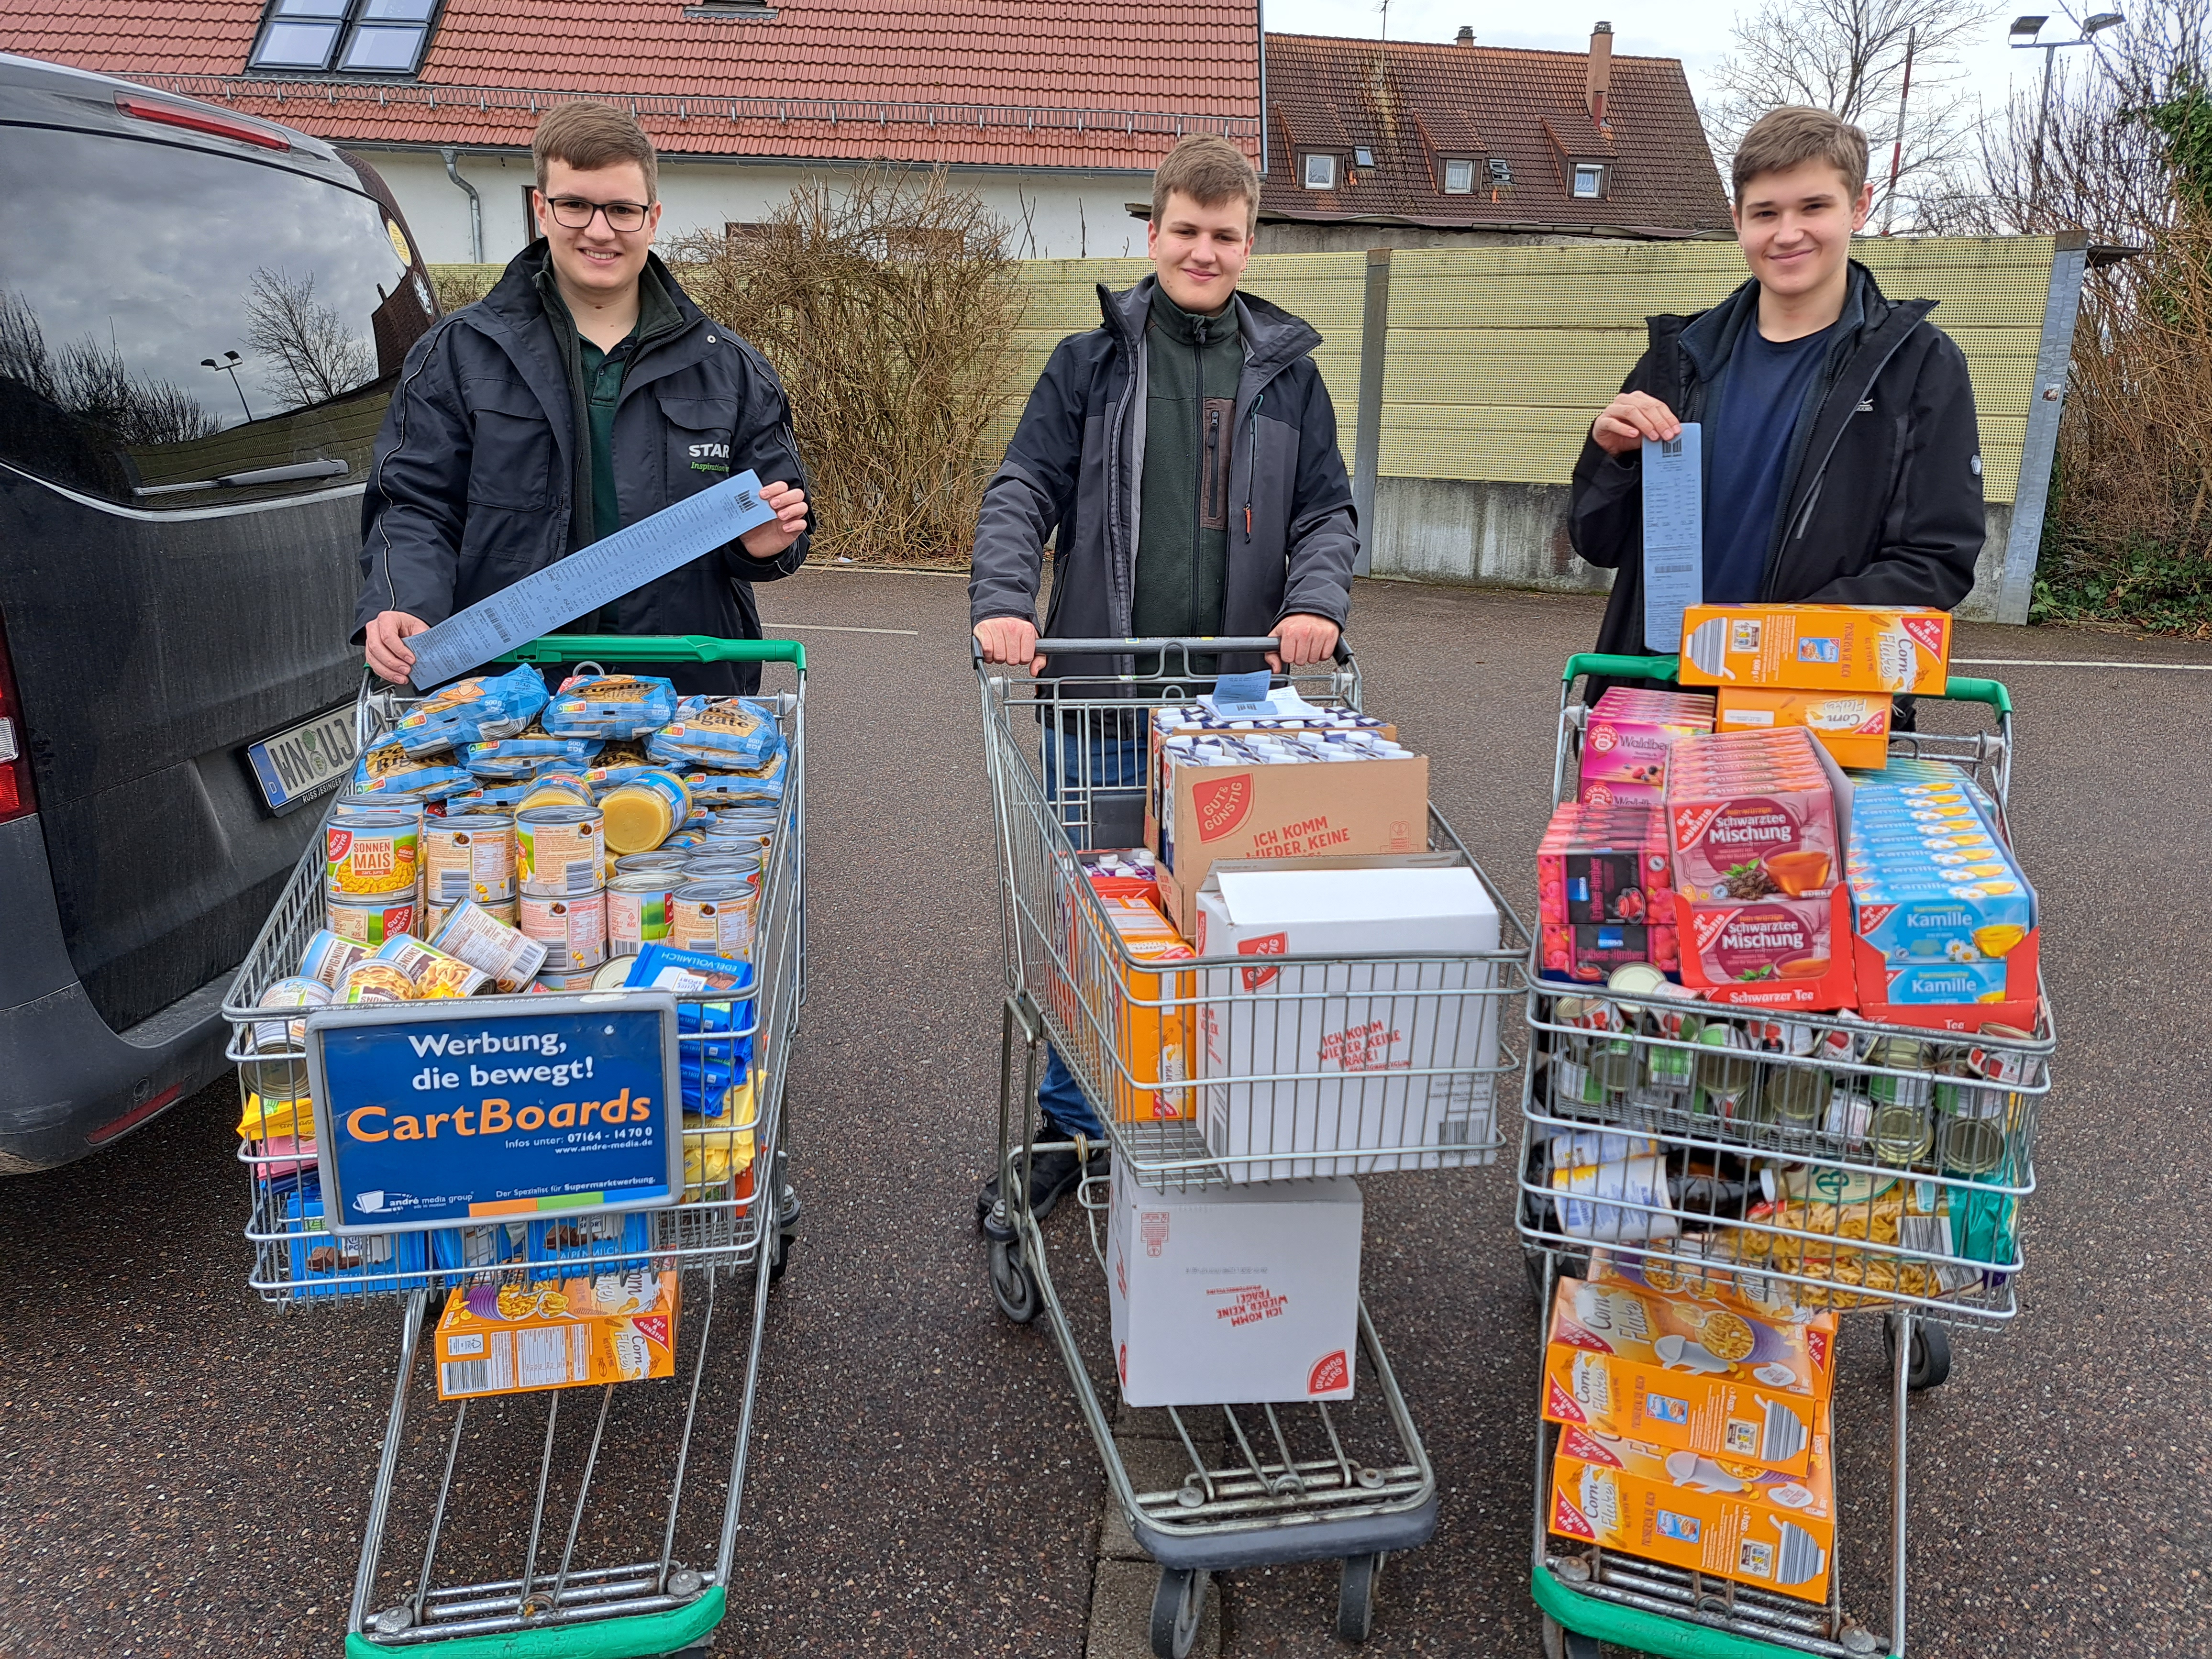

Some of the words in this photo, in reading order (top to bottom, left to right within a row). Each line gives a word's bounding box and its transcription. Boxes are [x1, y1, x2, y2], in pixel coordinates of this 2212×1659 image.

[1908, 622, 1938, 650] GÜNSTIG
[1924, 620, 1941, 634] GUT
[1879, 632, 1896, 679] Flakes
[1898, 638, 1914, 675] Corn
[1824, 698, 1867, 712] Flakes
[1825, 714, 1860, 726] Corn
[270, 737, 315, 790] WN
[317, 718, 355, 767] UJ
[268, 781, 277, 795] D
[302, 792, 318, 804] RUSS
[1204, 781, 1243, 831] GÜNSTIG
[1253, 830, 1278, 847] ICH
[1282, 816, 1329, 841] KOMM
[1715, 814, 1786, 828] Schwarztee
[329, 833, 348, 857] GÜNSTIG
[1308, 827, 1350, 850] KEINE
[1710, 825, 1792, 844] Mischung
[354, 842, 390, 852] SONNEN
[354, 852, 391, 869] MAIS
[387, 909, 409, 937] GÜNSTIG
[1728, 921, 1798, 934] Schwarztee
[1907, 912, 1972, 928] Kamille
[1723, 932, 1804, 950] Mischung
[322, 941, 349, 985] AMPIGNONS
[1729, 991, 1792, 1004] Schwarzer
[1793, 989, 1814, 1001] Tee
[1912, 979, 1977, 994] Kamille
[1944, 1019, 1965, 1030] Tee
[409, 1031, 567, 1058] Werbung,
[412, 1069, 460, 1091] die
[471, 1056, 594, 1088] bewegt!
[346, 1087, 651, 1143] CartBoards
[505, 1139, 530, 1149] Infos
[534, 1137, 564, 1146] unter:
[568, 1131, 601, 1143] 07164
[555, 1139, 653, 1154] www.andre-media.de
[389, 1196, 419, 1206] andré
[422, 1195, 446, 1204] media
[448, 1194, 473, 1203] group
[496, 1190, 511, 1198] Der
[514, 1186, 549, 1196] Spezialist
[597, 1276, 616, 1303] akes
[627, 1272, 643, 1296] orn
[652, 1317, 666, 1329] GUT
[1217, 1305, 1245, 1319] KEINE
[1231, 1311, 1262, 1327] KOMM
[1266, 1306, 1283, 1318] ICH
[1582, 1296, 1612, 1330] Corn
[1617, 1300, 1651, 1345] Flakes
[639, 1320, 665, 1342] GÜNSTIG
[614, 1331, 631, 1371] Flakes
[631, 1335, 645, 1366] Corn
[1315, 1356, 1343, 1390] GÜNSTIG
[1575, 1369, 1591, 1404] Corn
[1592, 1368, 1609, 1415] Flakes
[1583, 1483, 1599, 1518] Corn
[1601, 1482, 1618, 1531] Flakes
